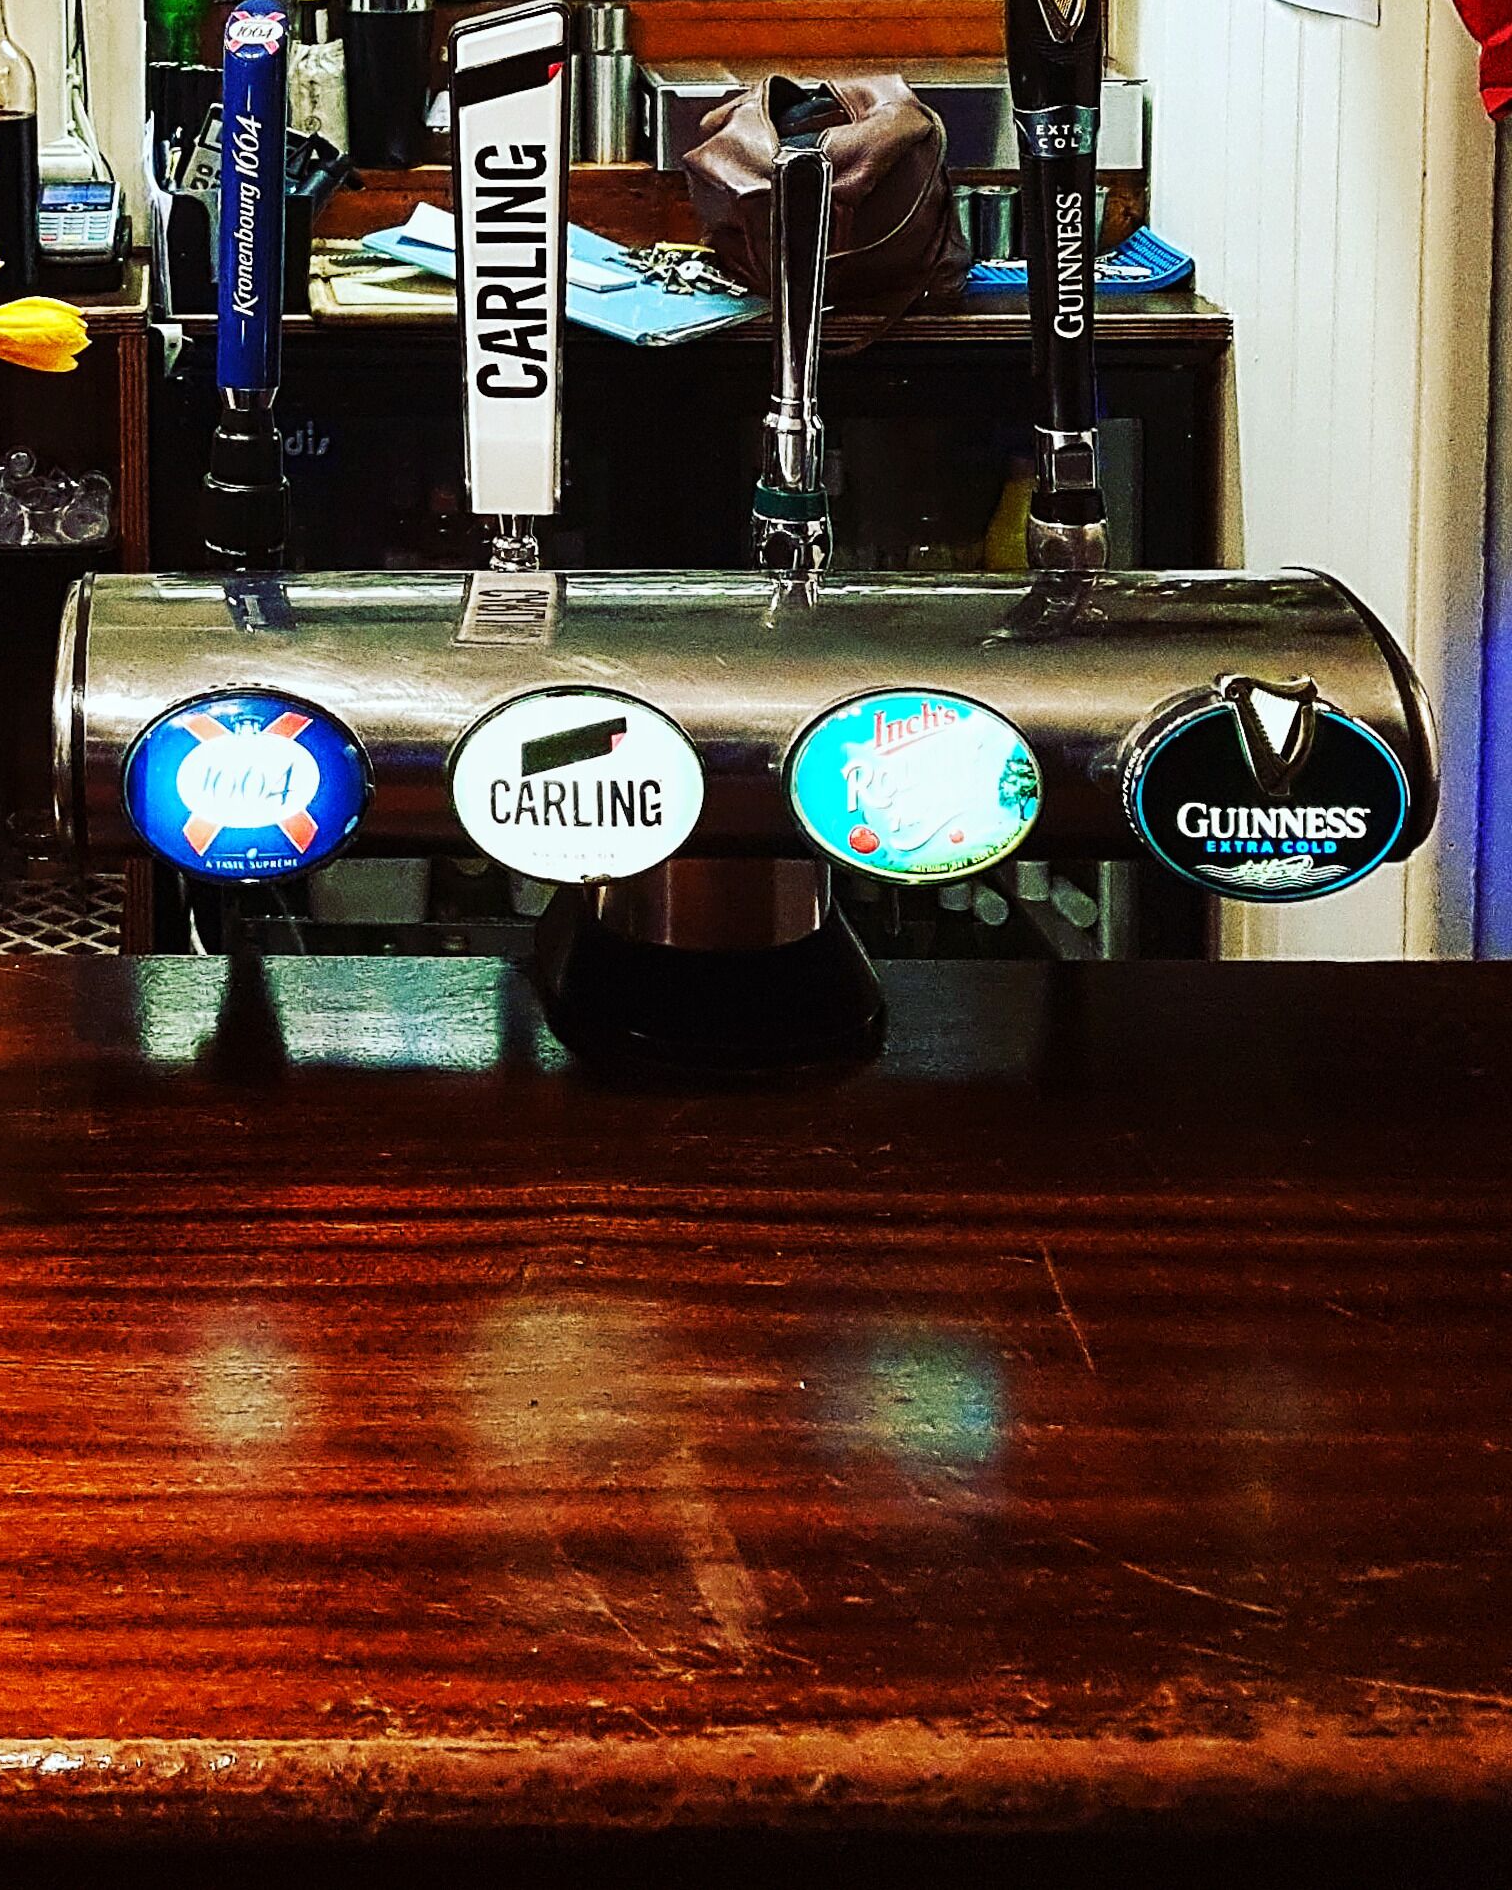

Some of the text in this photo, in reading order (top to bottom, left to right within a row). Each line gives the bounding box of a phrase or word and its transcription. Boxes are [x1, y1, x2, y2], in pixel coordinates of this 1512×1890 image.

[1035, 123, 1084, 136] EXTR
[1037, 137, 1079, 149] COL
[232, 114, 263, 317] Kronenbourg 1664
[474, 143, 548, 399] CARLING
[1052, 191, 1083, 339] GUINNESS
[873, 702, 957, 749] Inch's
[489, 778, 663, 828] CARLING
[1176, 801, 1369, 839] GUINNESS
[1205, 840, 1338, 854] EXTRA COLD
